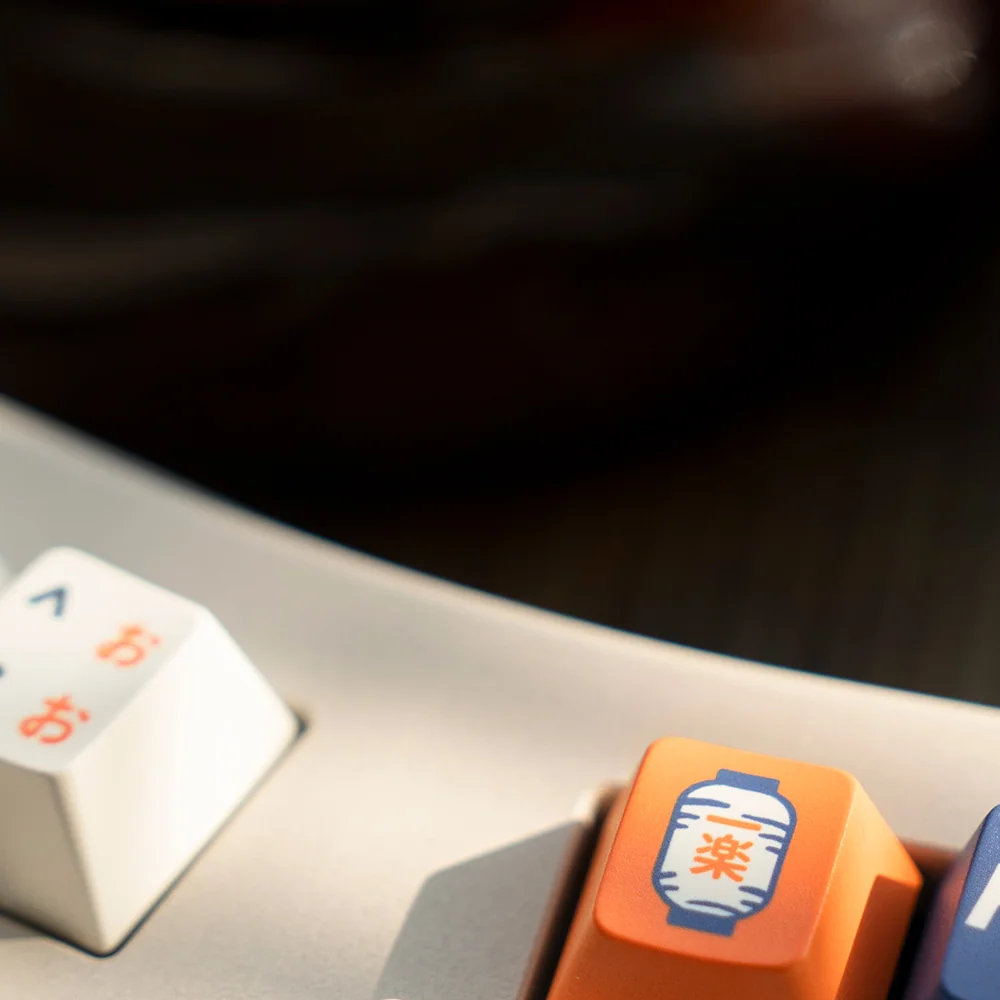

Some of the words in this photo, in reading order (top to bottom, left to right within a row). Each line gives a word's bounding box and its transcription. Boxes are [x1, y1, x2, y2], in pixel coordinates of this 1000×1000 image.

[95, 622, 162, 669] お
[18, 694, 92, 745] お
[690, 814, 763, 883] 一楽
